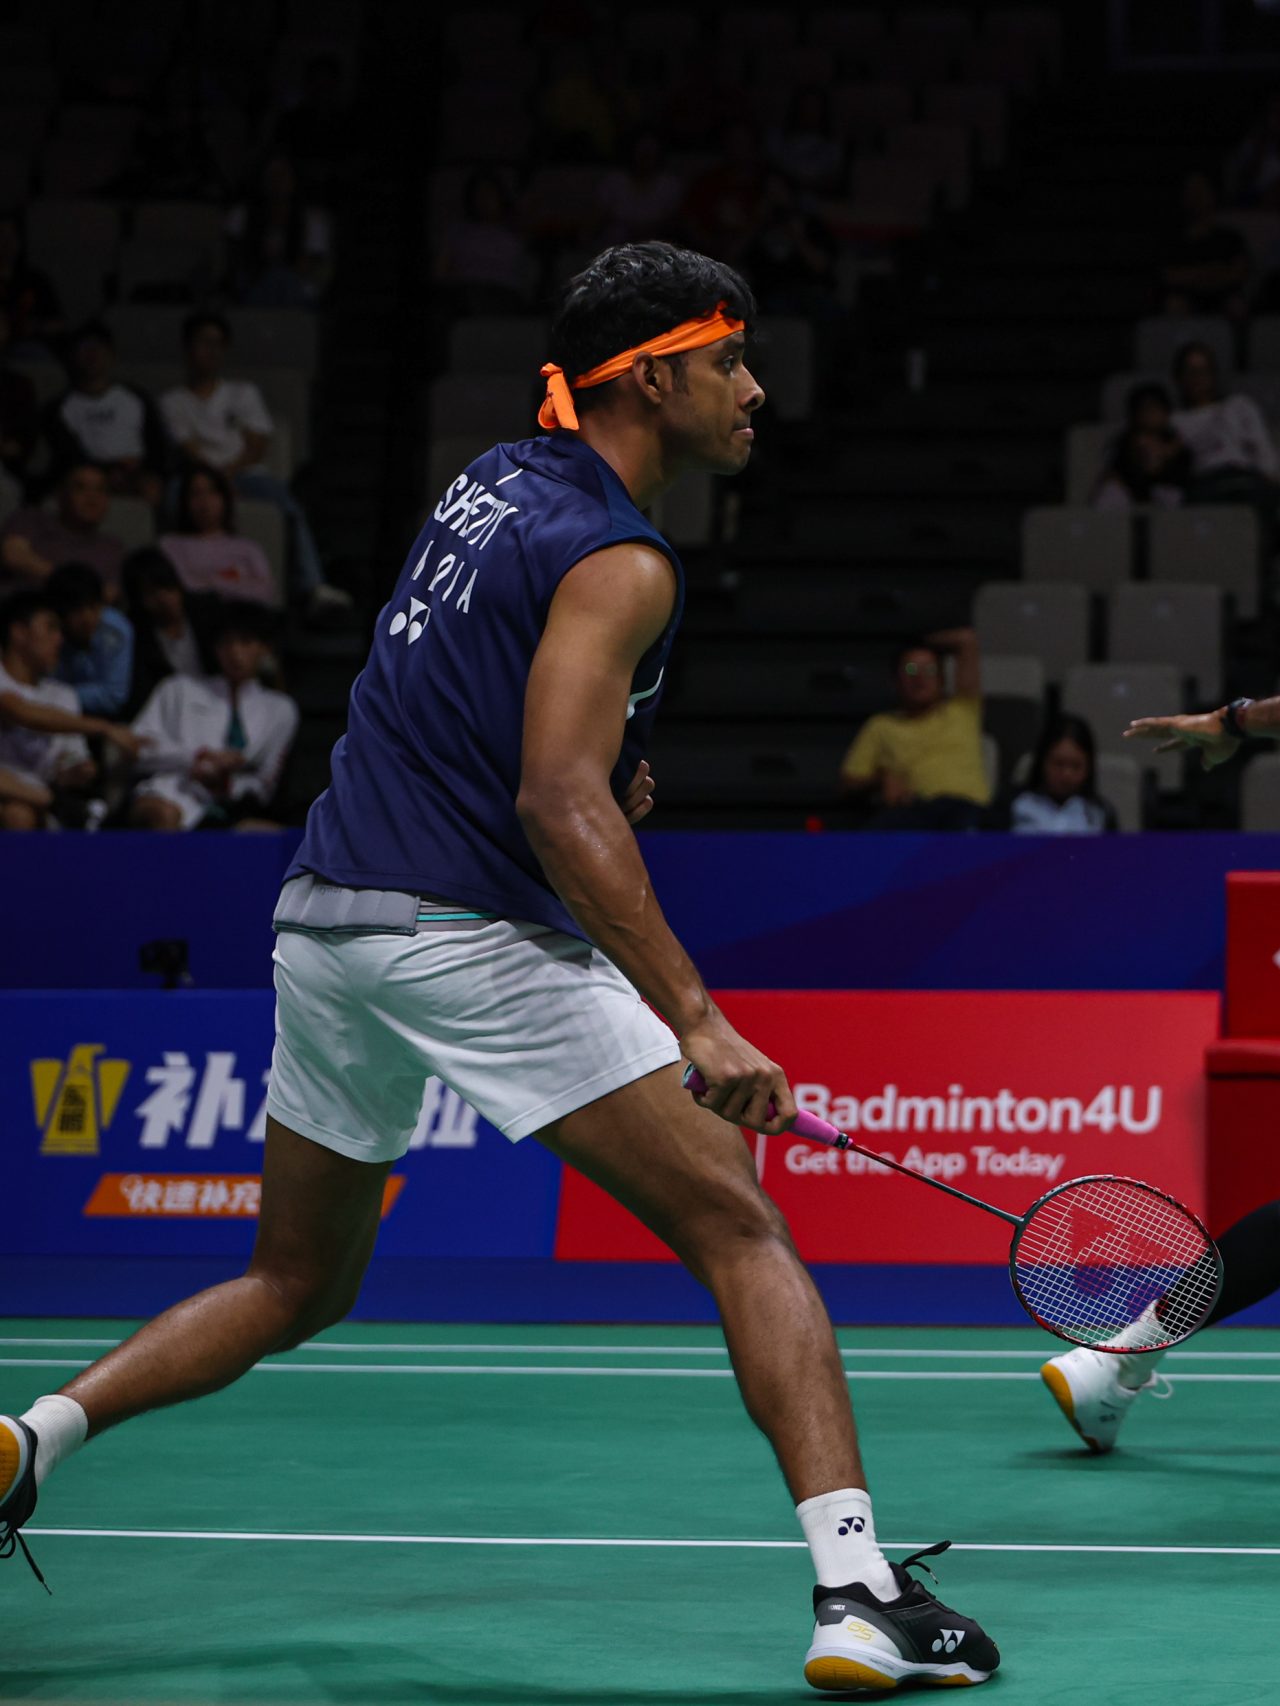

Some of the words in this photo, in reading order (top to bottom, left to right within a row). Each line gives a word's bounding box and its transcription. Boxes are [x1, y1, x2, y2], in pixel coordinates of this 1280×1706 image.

[794, 1084, 1162, 1132] Badminton4U
[785, 1144, 840, 1175] Get
[845, 1146, 896, 1175] the
[902, 1146, 968, 1180] App
[971, 1146, 1065, 1181] Today
